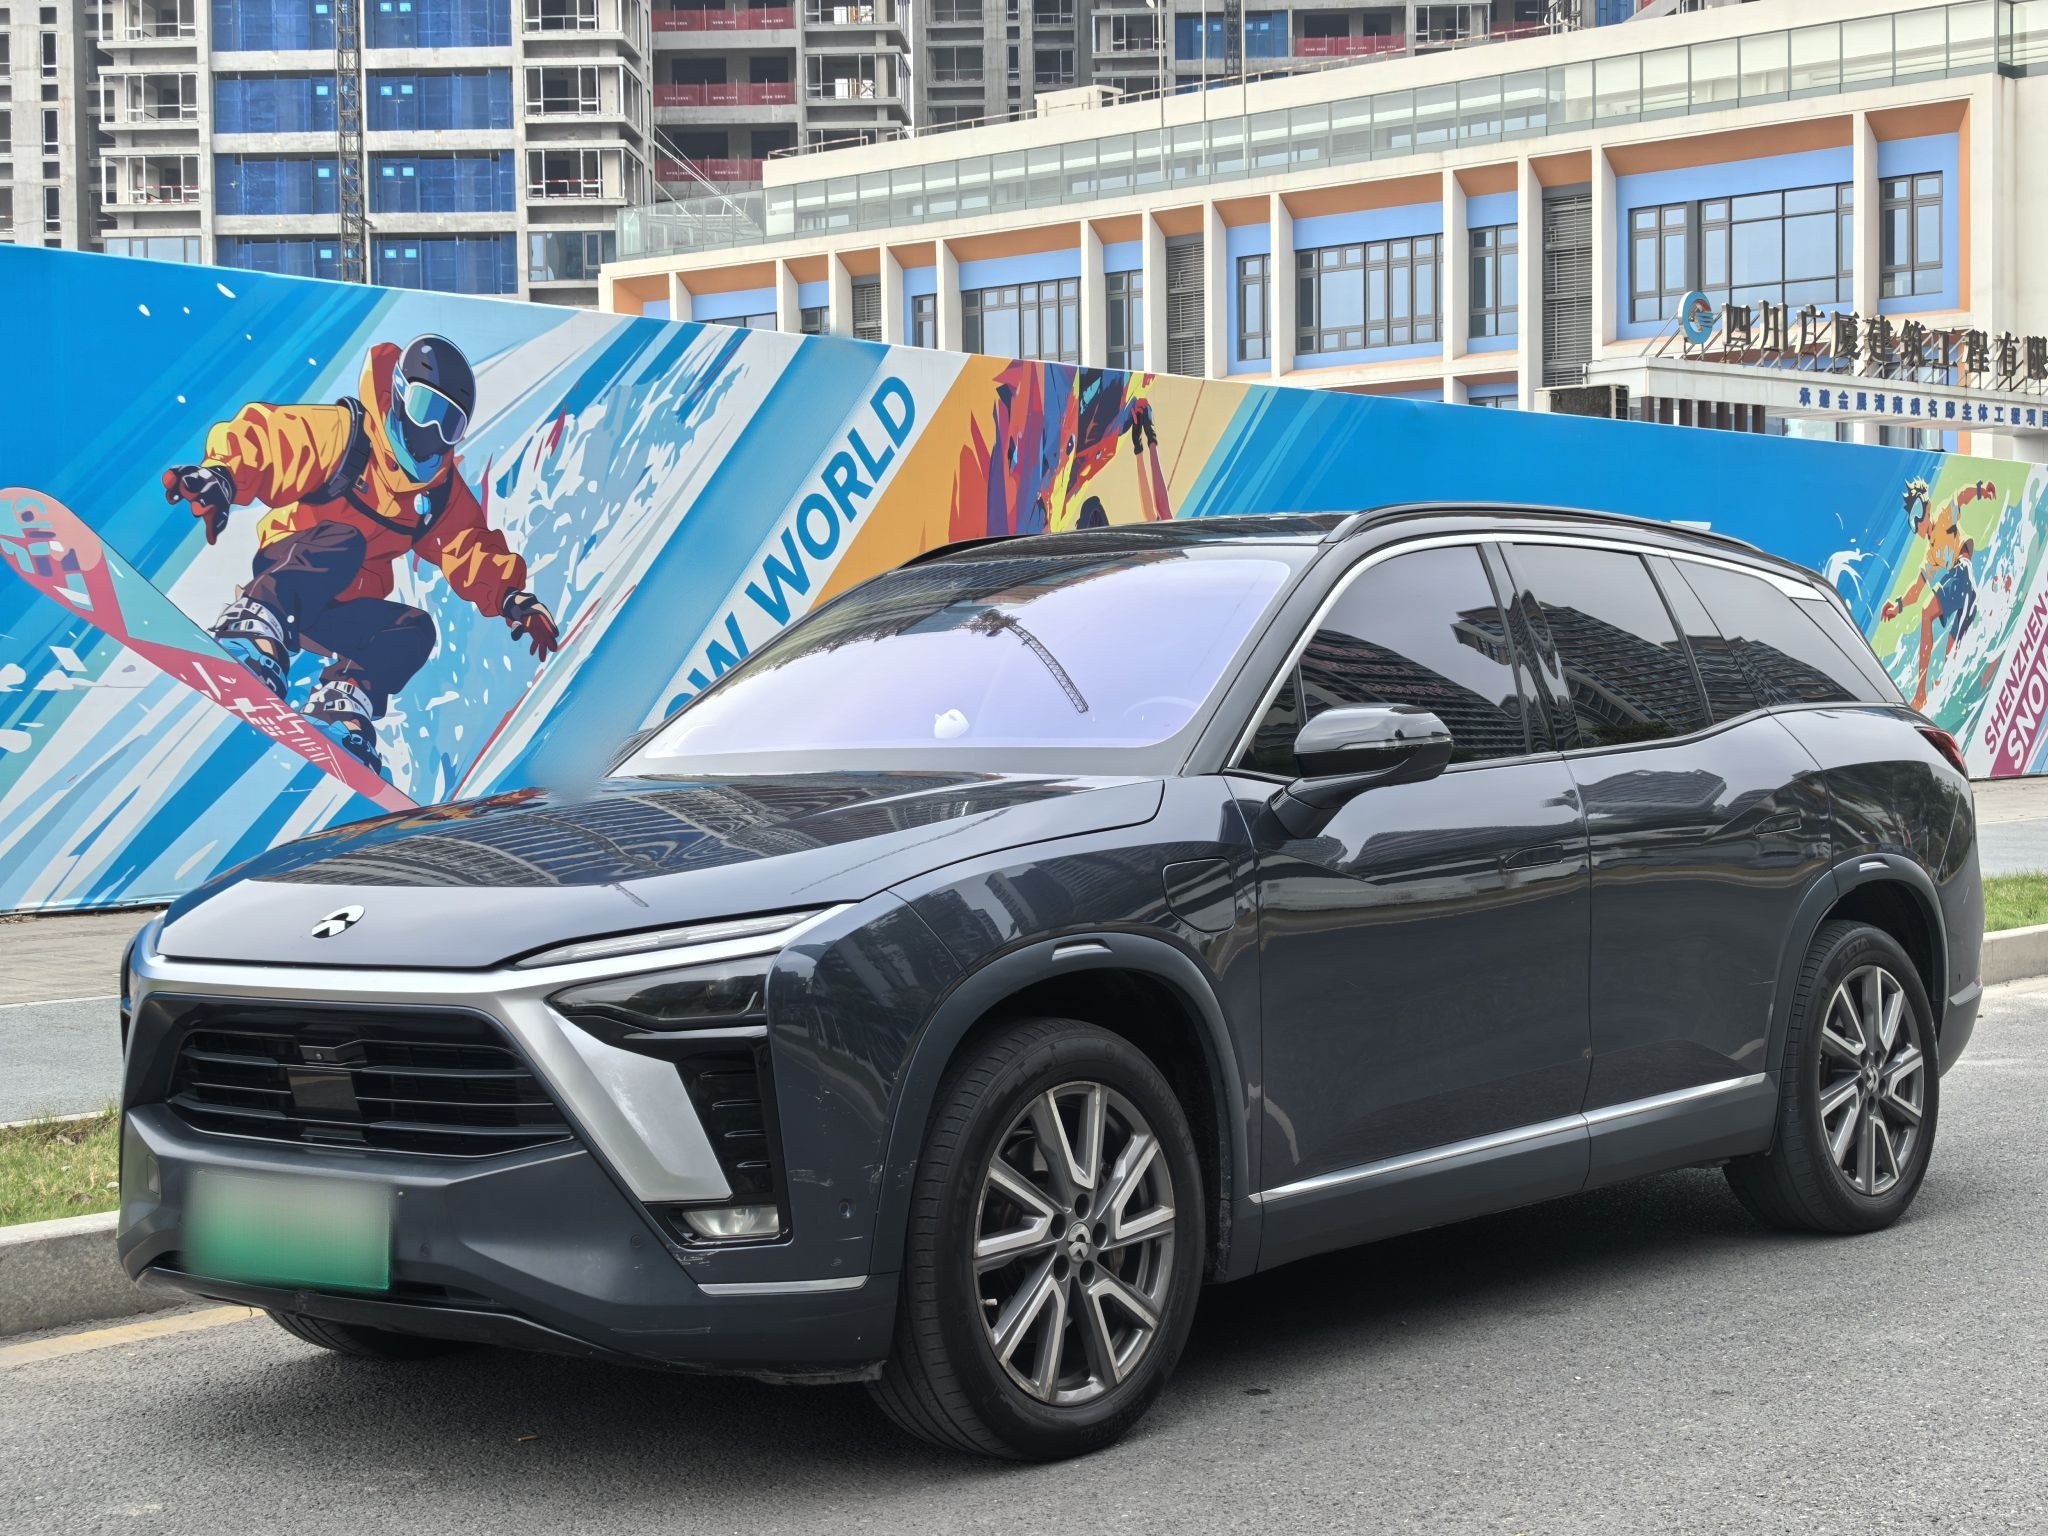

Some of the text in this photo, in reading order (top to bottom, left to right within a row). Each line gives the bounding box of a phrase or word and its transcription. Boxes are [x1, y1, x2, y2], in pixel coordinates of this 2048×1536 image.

[1721, 300, 2048, 380] 四川广厦建筑工程有限
[745, 376, 916, 627] WORLD
